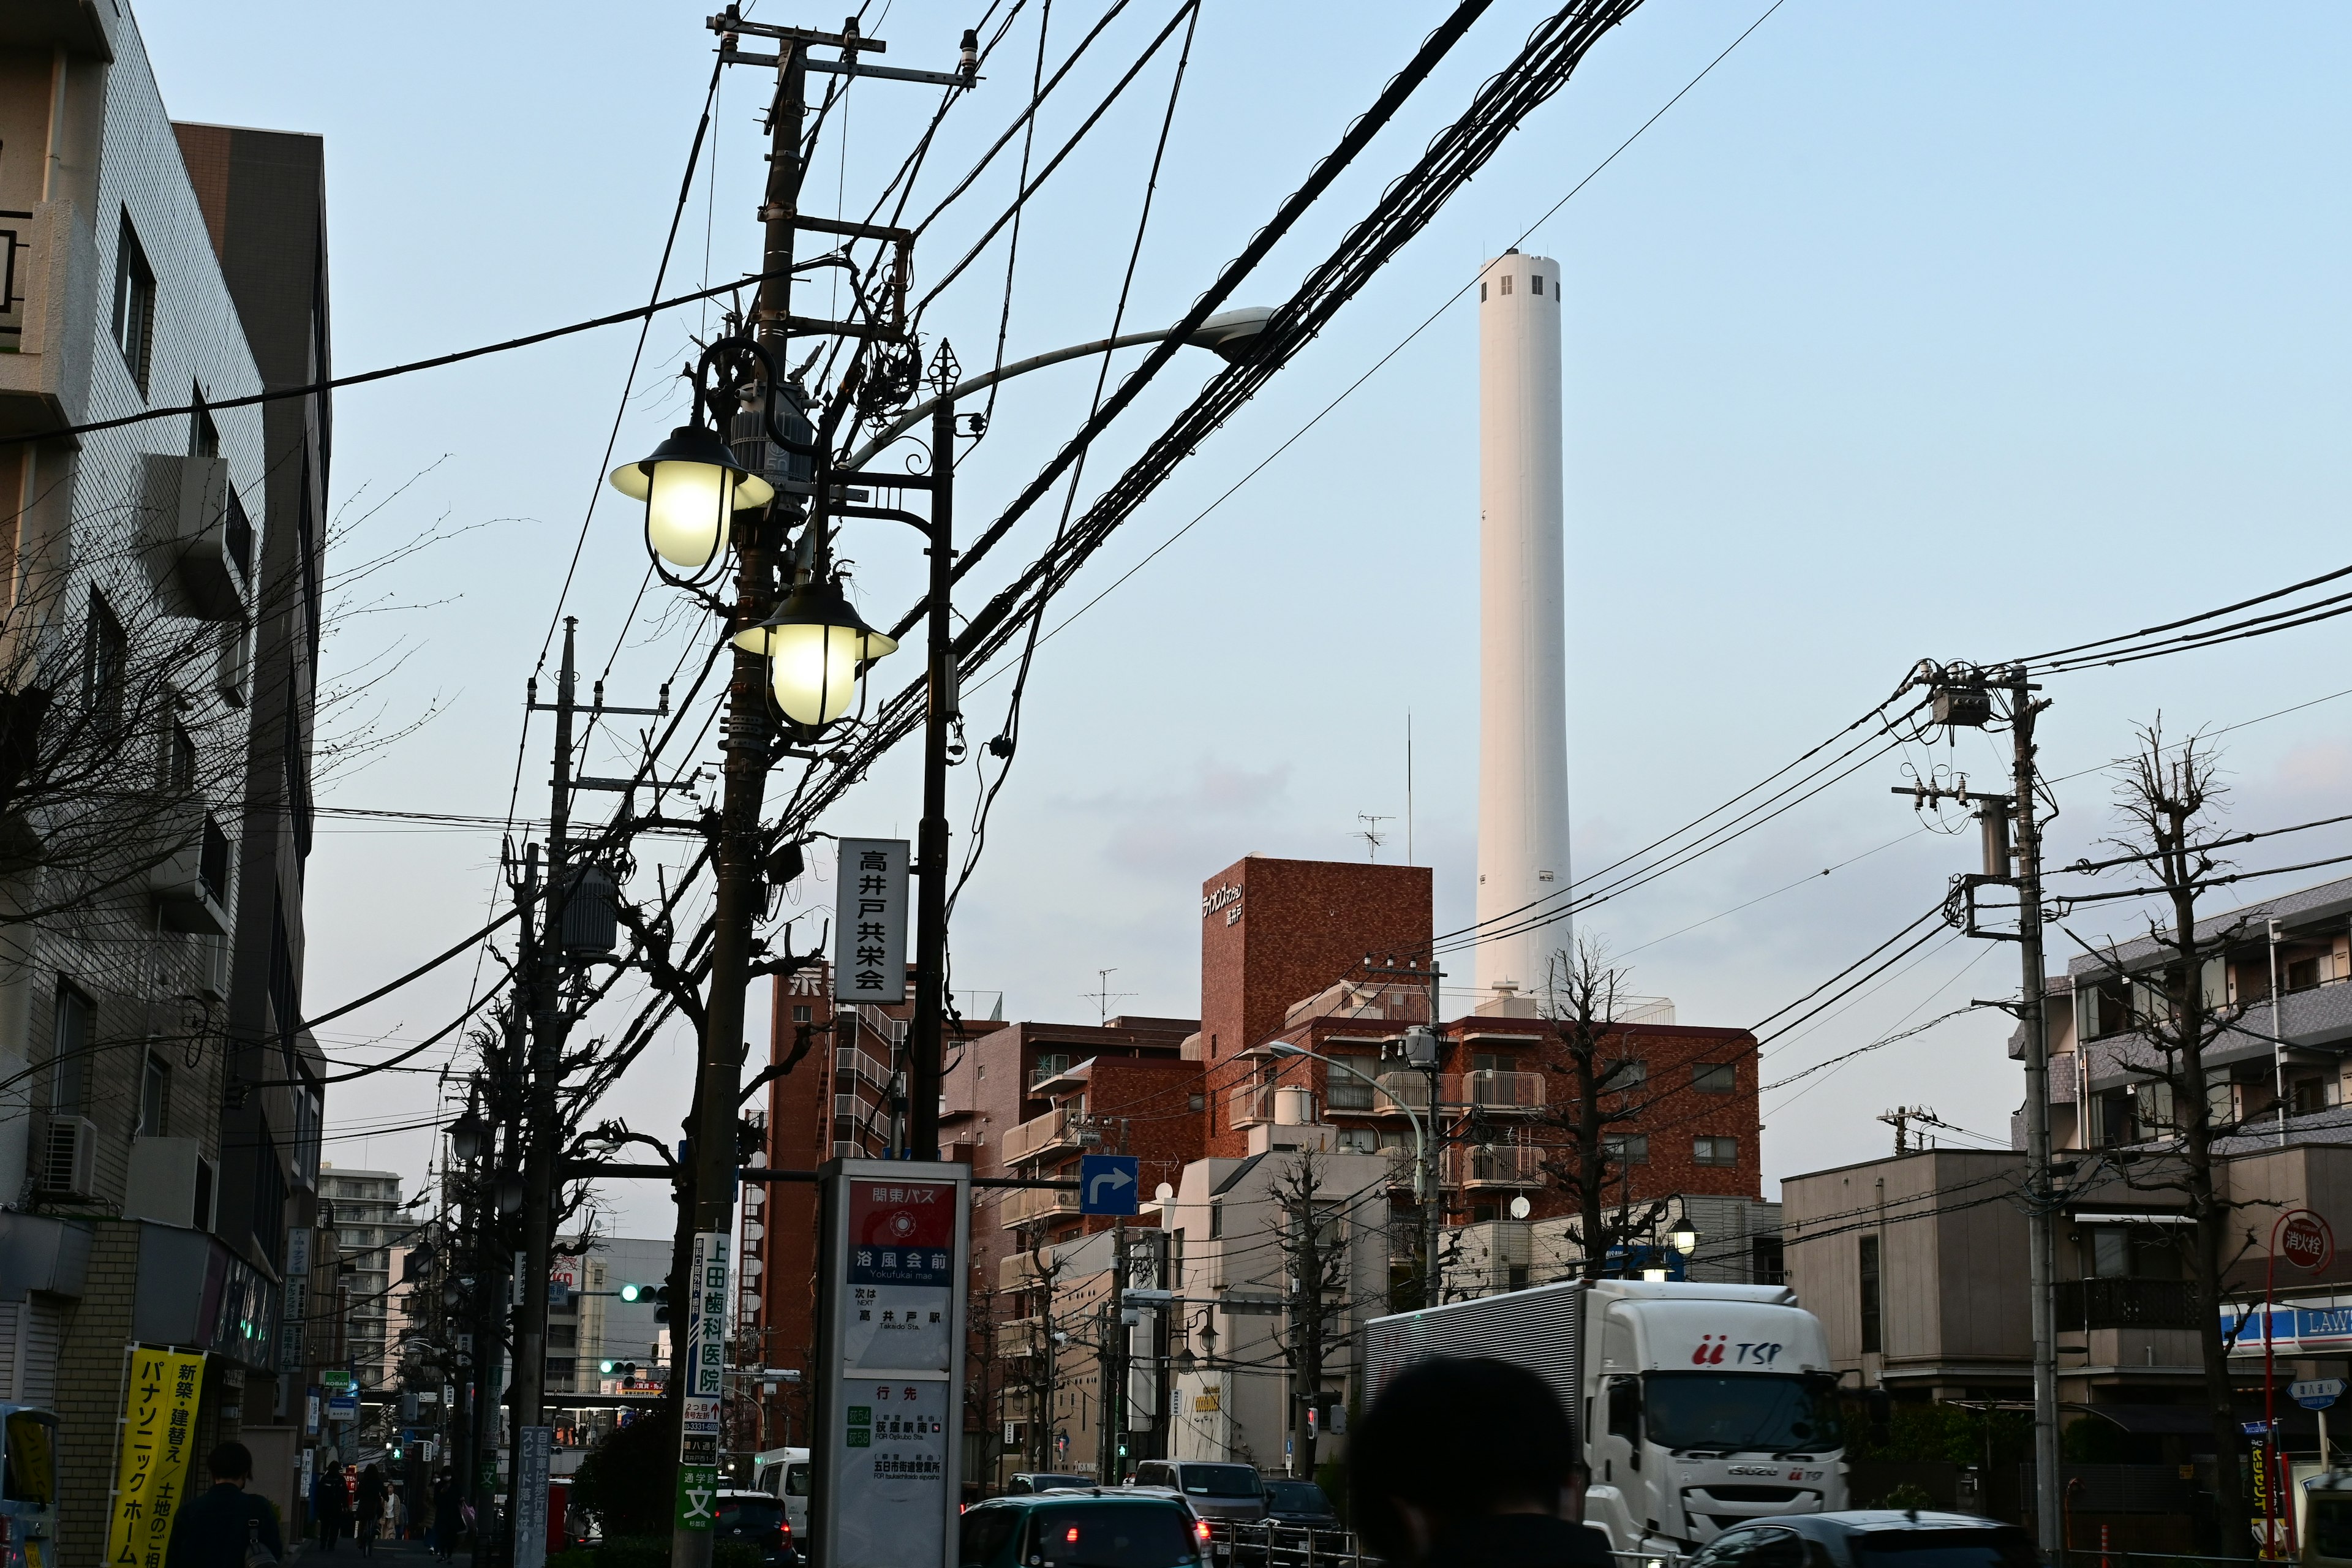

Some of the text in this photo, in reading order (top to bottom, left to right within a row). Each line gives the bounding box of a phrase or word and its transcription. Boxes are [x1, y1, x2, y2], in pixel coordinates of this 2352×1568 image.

[856, 851, 888, 990] 高井戸共栄会
[1226, 903, 1242, 928] 高井戸
[872, 1187, 935, 1204] 関東バス
[2286, 1230, 2321, 1255] 消火栓
[857, 1251, 946, 1270] 浴風会前
[870, 1270, 913, 1280] Yokufukai
[855, 1288, 876, 1298] 次は
[699, 1240, 726, 1392] 上田歯科医院
[859, 1310, 941, 1324] 高井戸駅
[2308, 1310, 2352, 1333] LAW
[1736, 1342, 1782, 1365] TSP
[876, 1386, 917, 1401] 行先
[684, 1411, 710, 1420] 信号左折
[848, 1409, 870, 1423] 荻54
[129, 1361, 165, 1493] パナソニック
[875, 1421, 940, 1434] 荻窪駅南口
[848, 1431, 869, 1445] 荻58
[684, 1441, 716, 1451] 環八通り
[874, 1460, 940, 1473] 五日市街道営業所
[1728, 1465, 1778, 1476] ISUZU
[518, 1431, 533, 1531] スピード落とせ
[684, 1472, 715, 1483] 通学路
